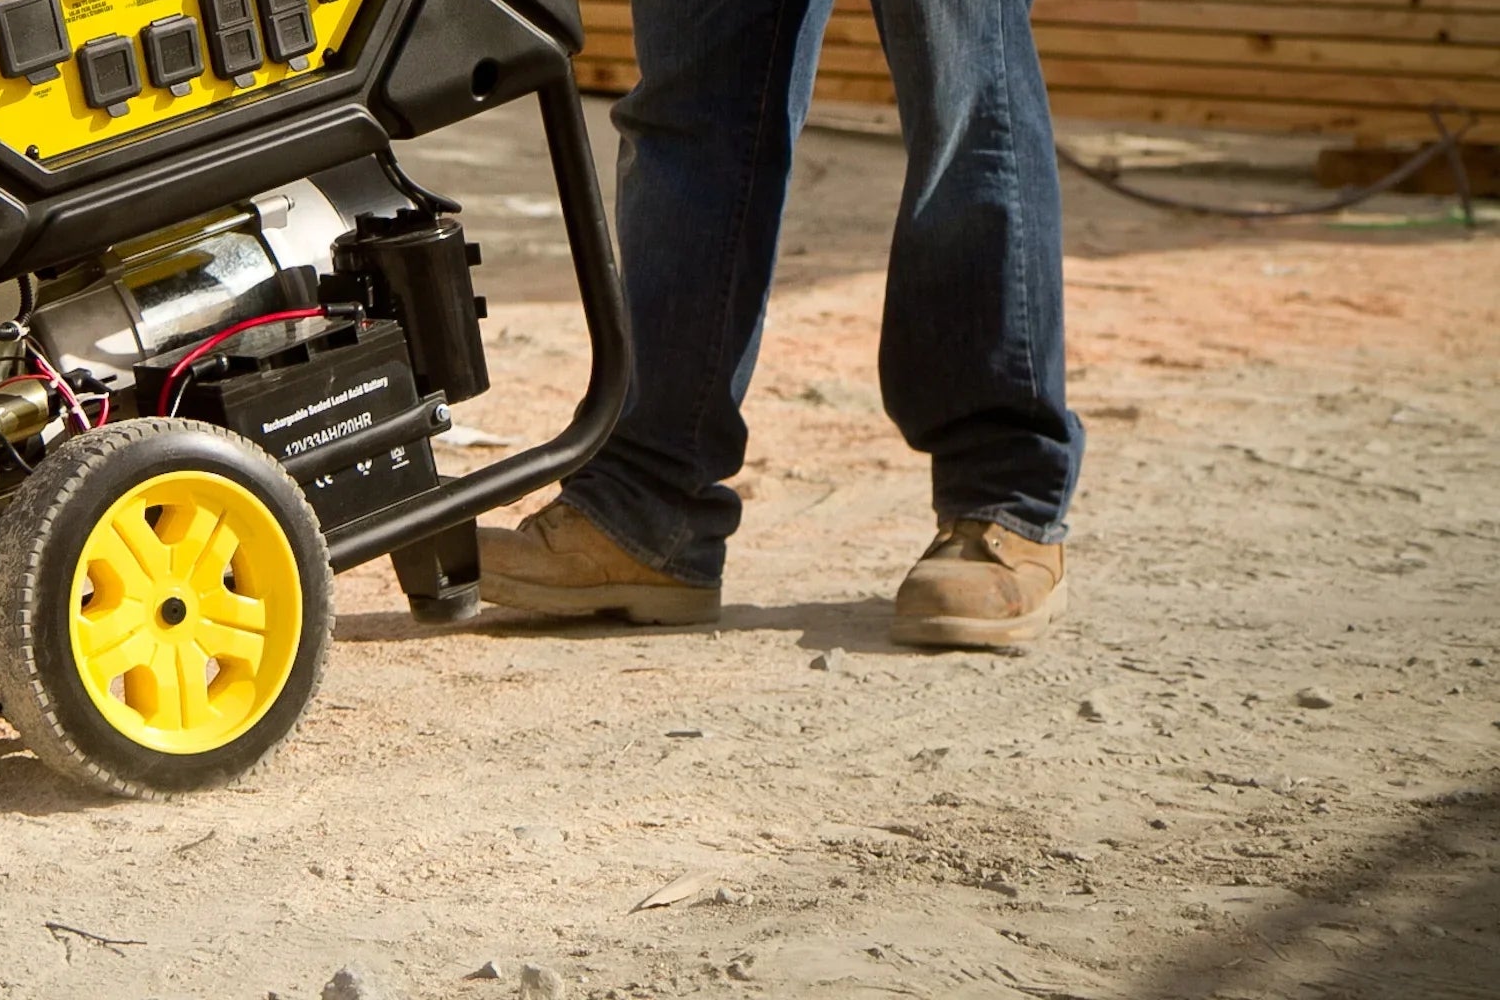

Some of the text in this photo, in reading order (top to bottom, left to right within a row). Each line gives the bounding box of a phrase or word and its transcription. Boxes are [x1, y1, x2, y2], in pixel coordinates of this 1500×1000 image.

[263, 376, 389, 433] Rechargeable Sealed Lead Acid Battery
[285, 411, 373, 457] 12V33AH/20HR
